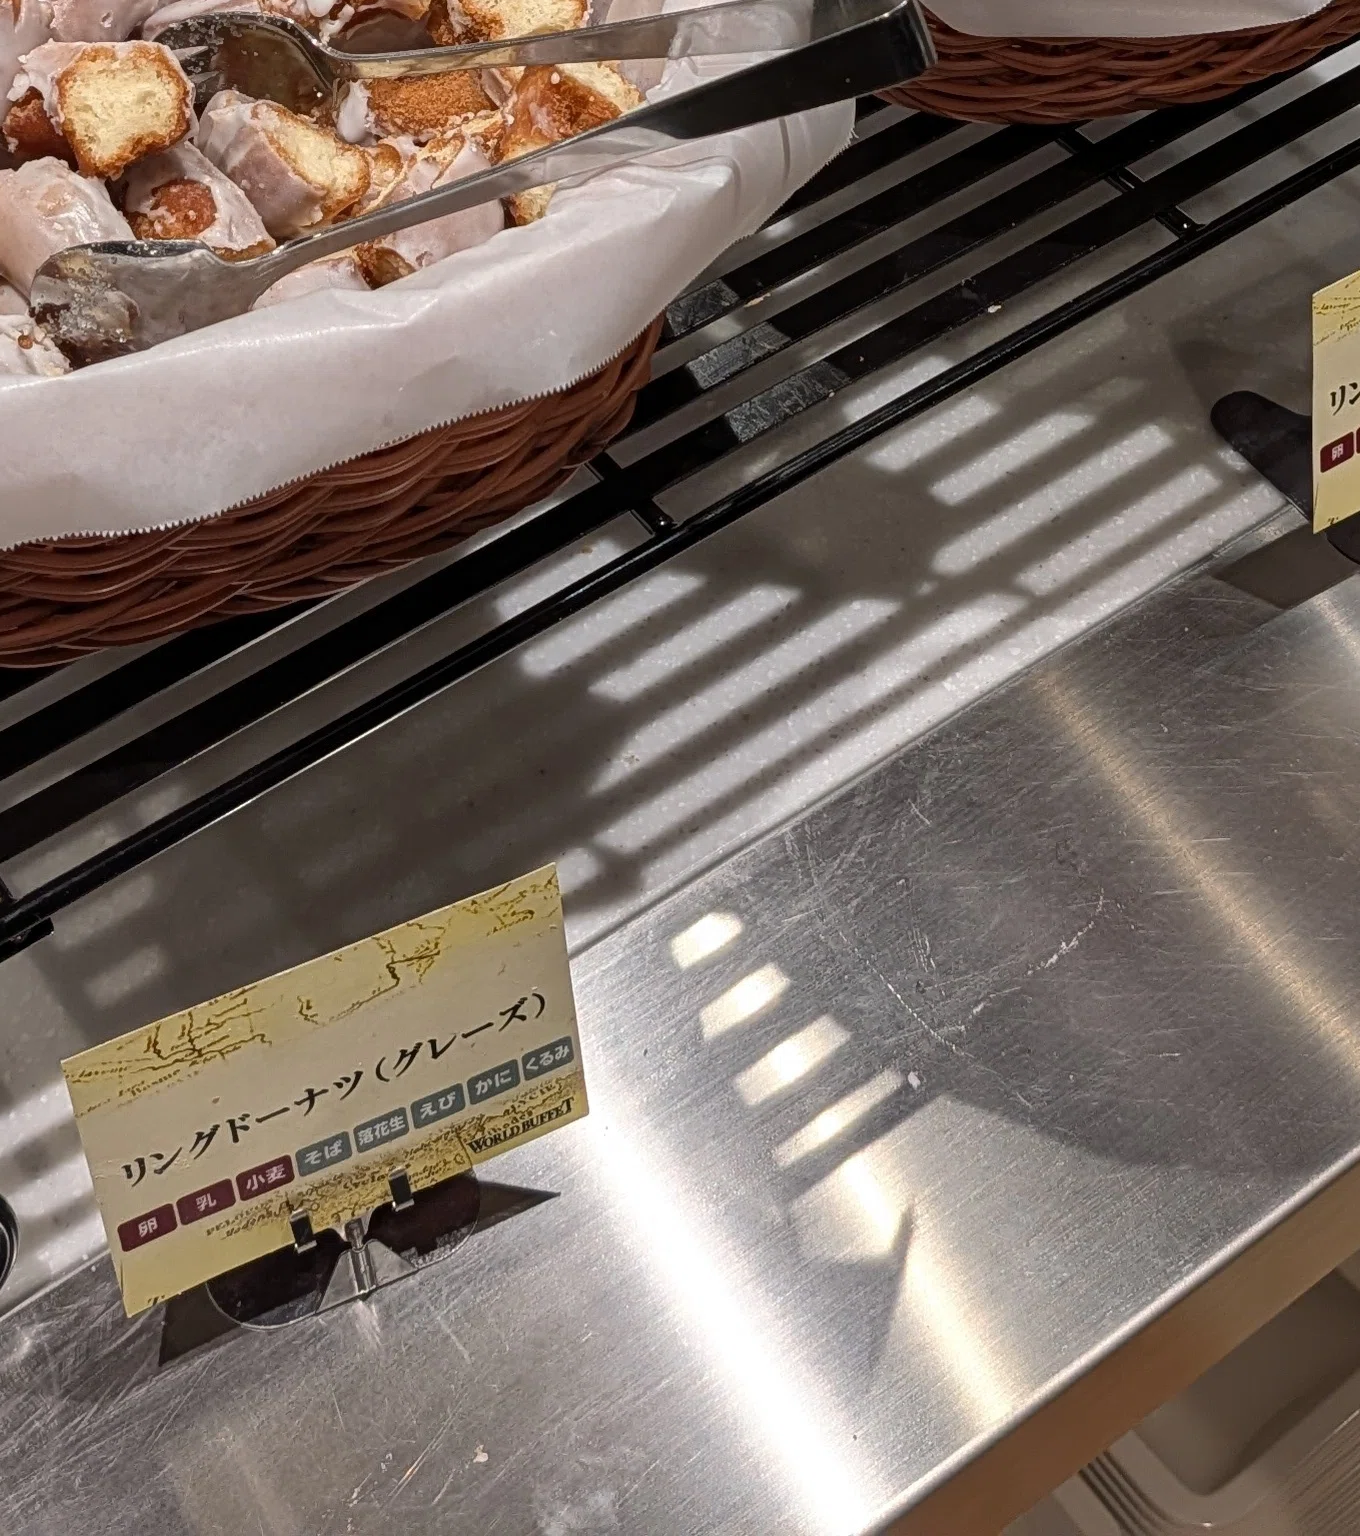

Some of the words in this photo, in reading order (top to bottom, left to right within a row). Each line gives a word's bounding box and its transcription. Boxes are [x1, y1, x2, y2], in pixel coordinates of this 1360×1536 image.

[1331, 443, 1344, 461] 卵
[121, 993, 546, 1187] リングドーナツ（グレーズ）
[138, 1216, 158, 1236] 卵
[195, 1193, 217, 1211] 乳
[246, 1164, 287, 1191] 小麦
[304, 1140, 342, 1165] そば
[357, 1116, 405, 1145] 落花生
[419, 1091, 456, 1120] えび
[475, 1068, 512, 1096] かに
[525, 1043, 570, 1073] くるみ
[466, 1125, 521, 1154] WORLD
[522, 1097, 575, 1131] BUFFET
